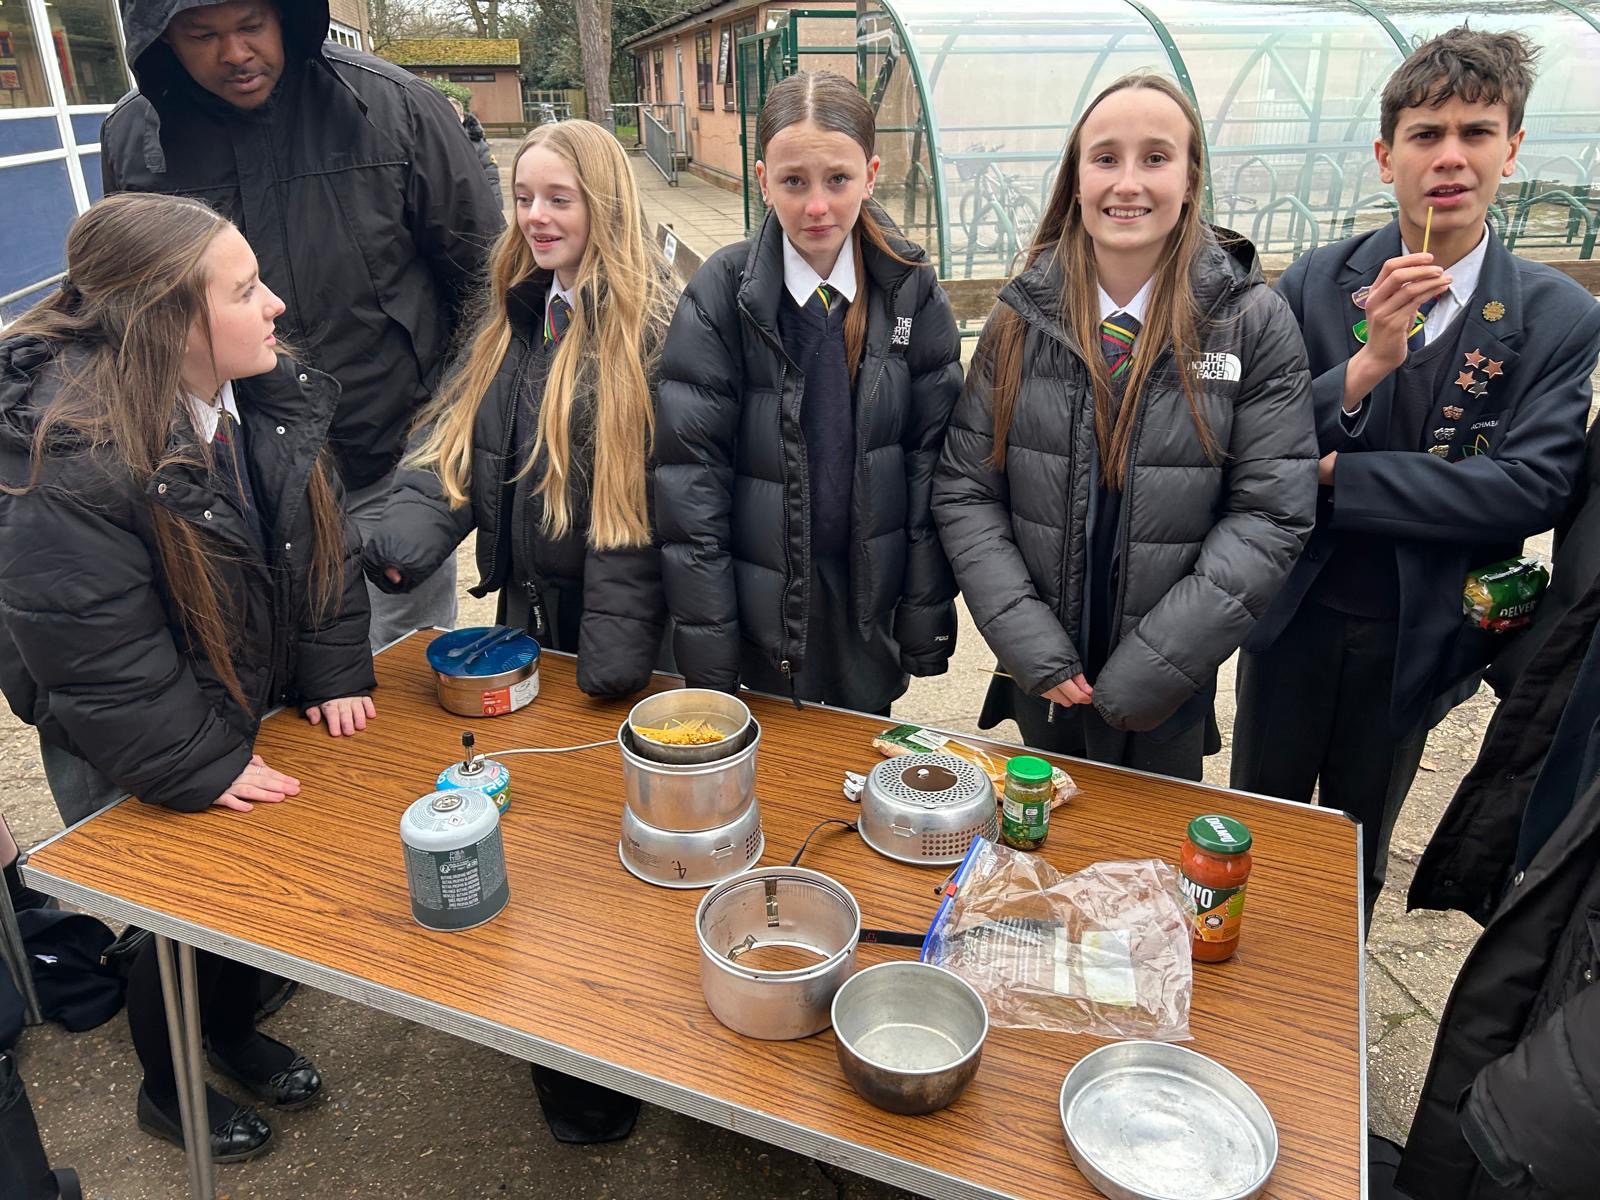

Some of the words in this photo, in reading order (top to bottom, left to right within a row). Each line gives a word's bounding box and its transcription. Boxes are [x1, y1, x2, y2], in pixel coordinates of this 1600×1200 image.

[897, 316, 912, 327] THE
[894, 326, 910, 336] RTH
[1204, 352, 1226, 362] THE
[1196, 370, 1224, 380] FACE
